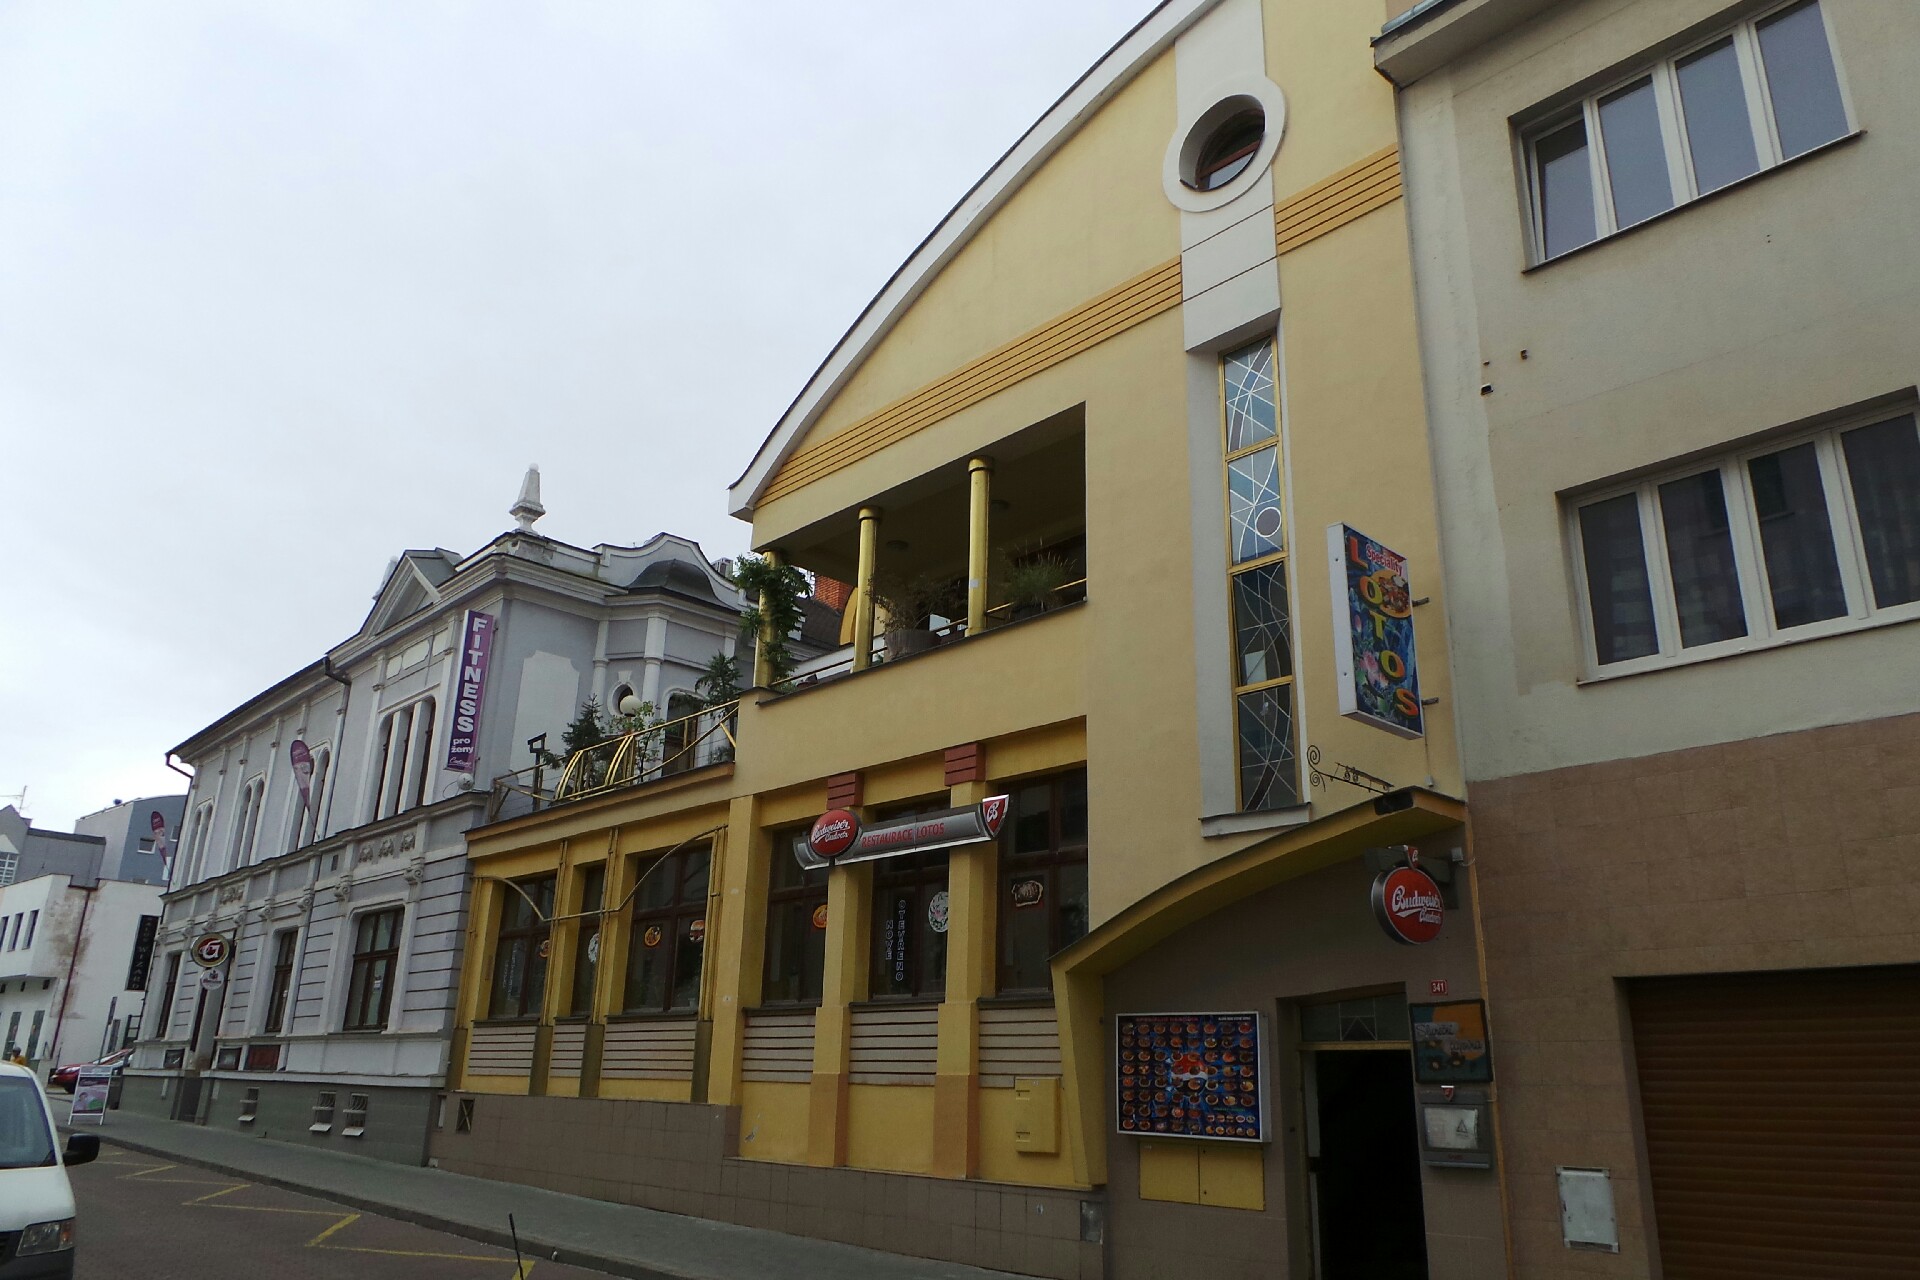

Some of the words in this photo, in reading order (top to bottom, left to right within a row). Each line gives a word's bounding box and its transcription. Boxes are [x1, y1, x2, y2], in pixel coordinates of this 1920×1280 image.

[1366, 544, 1402, 576] Speciality
[1348, 536, 1419, 719] LOTOS
[457, 617, 488, 733] FITNESS
[451, 745, 474, 754] ženy
[811, 819, 850, 843] Budweiser
[861, 828, 913, 848] RESTAURACE
[917, 822, 945, 839] LOTOS
[1392, 885, 1442, 912] Budweiser
[1431, 982, 1444, 992] 341
